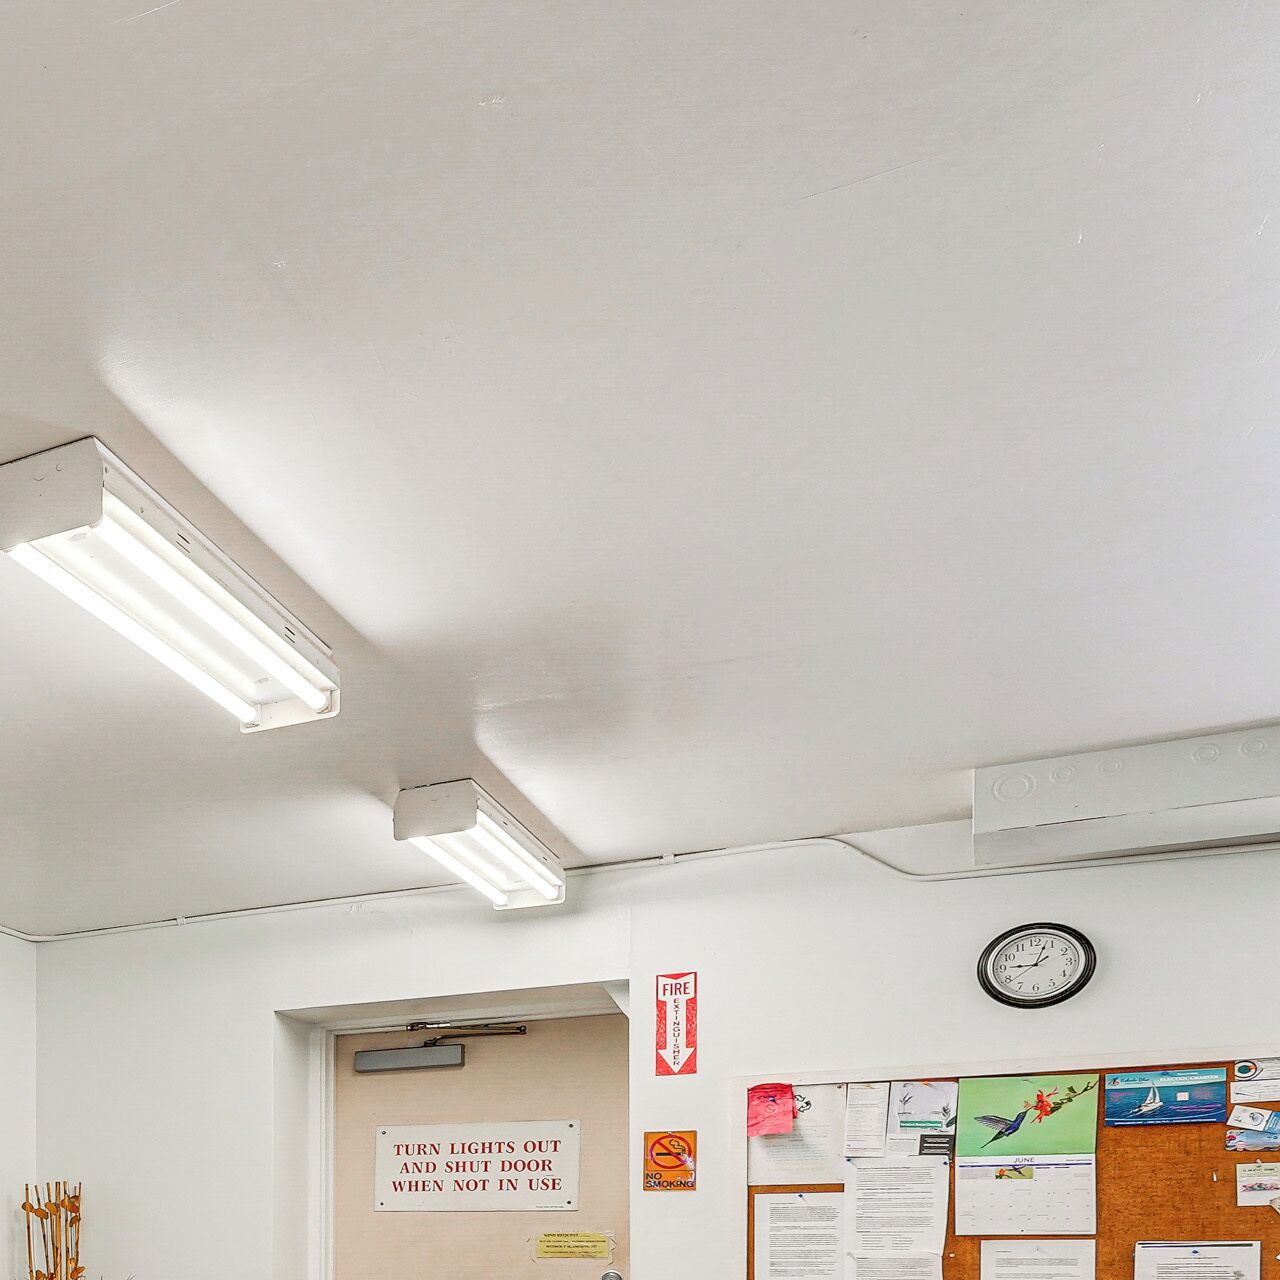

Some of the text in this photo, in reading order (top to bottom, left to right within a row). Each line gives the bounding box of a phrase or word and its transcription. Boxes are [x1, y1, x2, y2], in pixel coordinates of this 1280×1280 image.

[1029, 938, 1041, 947] 12
[1050, 940, 1054, 948] 1
[1015, 944, 1025, 952] 11
[1060, 947, 1068, 956] 2
[1004, 953, 1015, 962] 10
[1066, 957, 1073, 966] 3
[999, 964, 1006, 973] 9
[1060, 969, 1066, 977] 4
[1004, 975, 1012, 984] 8
[1049, 979, 1055, 987] 5
[663, 982, 690, 996] FIRE
[1017, 982, 1024, 990] 7
[1032, 983, 1040, 992] 6
[393, 1140, 561, 1156] TURN LIGHTS OUT
[400, 1159, 552, 1174] AND SHUT DOOR
[646, 1172, 662, 1180] NO
[392, 1178, 562, 1192] WHEN NOT IN USE
